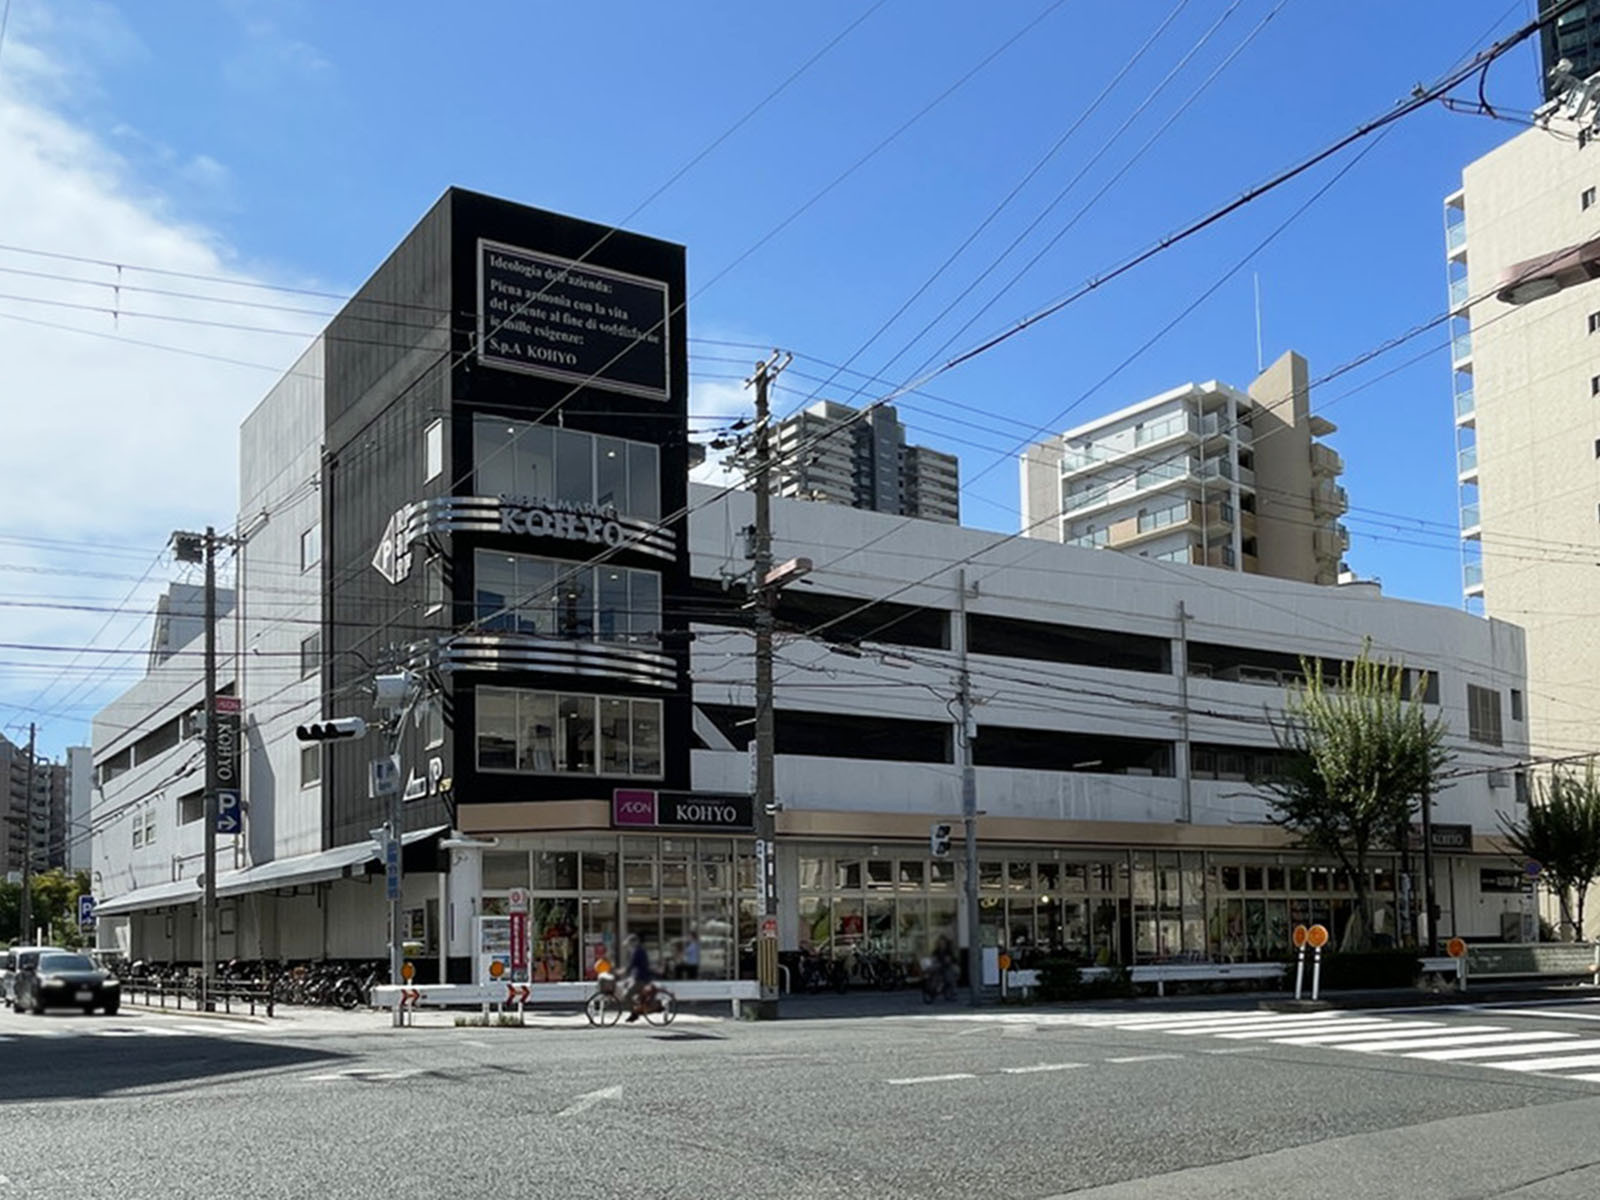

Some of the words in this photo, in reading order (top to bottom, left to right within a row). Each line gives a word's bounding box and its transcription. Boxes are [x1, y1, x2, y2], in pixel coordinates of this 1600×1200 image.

[489, 254, 542, 277] Ideologia
[489, 280, 522, 297] Piena
[524, 289, 571, 308] armonia
[573, 300, 593, 312] con
[595, 302, 606, 314] la
[608, 307, 628, 321] vita
[489, 297, 508, 311] del
[510, 302, 547, 319] cliente
[549, 310, 561, 322] al
[563, 313, 583, 328] fine
[585, 317, 597, 330] di
[489, 315, 501, 326] le
[502, 319, 532, 334] mille
[527, 345, 578, 365] KOHYO
[499, 507, 624, 547] KOHYO
[217, 723, 233, 781] KOHYO
[219, 793, 237, 815] P
[676, 804, 737, 823] KOHYO
[82, 902, 93, 915] P
